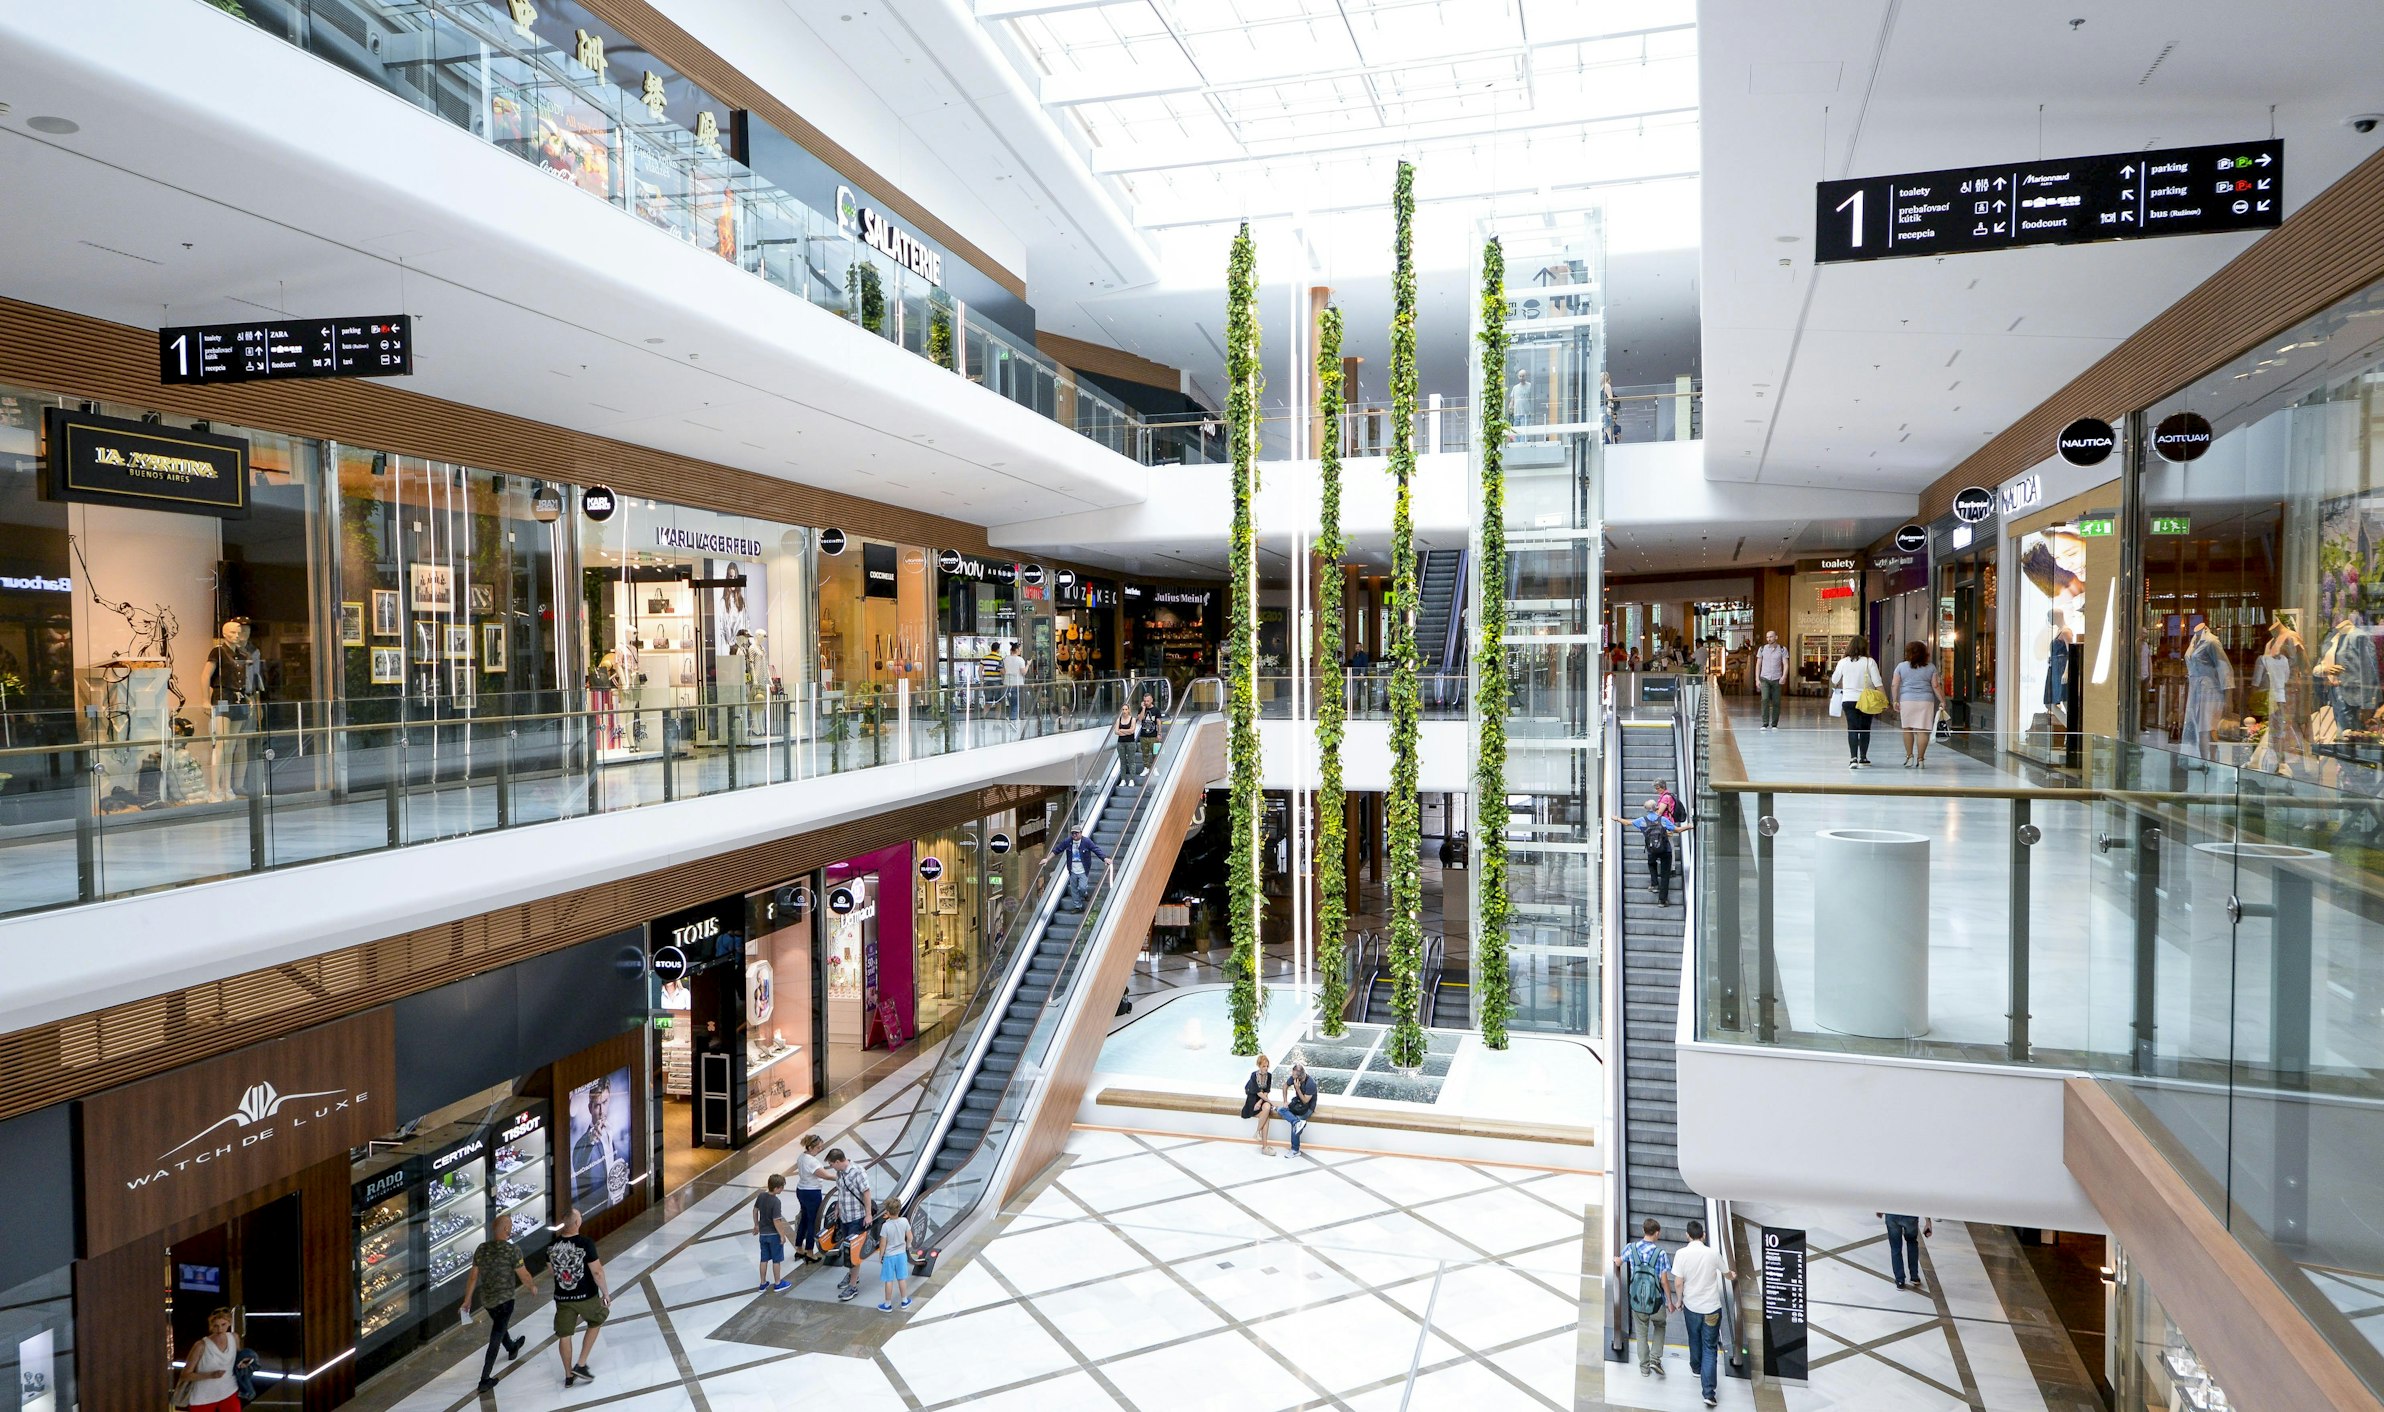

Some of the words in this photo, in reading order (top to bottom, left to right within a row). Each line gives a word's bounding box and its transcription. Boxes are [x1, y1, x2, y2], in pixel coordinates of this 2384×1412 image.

[2151, 162, 2188, 175] parking
[2022, 172, 2070, 186] Marionnaud
[1899, 186, 1931, 197] toalety
[2150, 186, 2188, 198] parking
[1899, 202, 1950, 215] prebaľovací
[2150, 209, 2168, 218] bus
[1836, 190, 1864, 247] 1
[1899, 213, 1922, 223] kútik
[2022, 218, 2067, 229] foodcourt
[1898, 229, 1936, 240] recepcia
[863, 207, 941, 287] SALATERIE
[341, 327, 361, 336] parking
[170, 335, 187, 375] 1
[271, 361, 297, 369] foodcourt
[2062, 438, 2113, 448] NAUTICA
[129, 469, 163, 480] BUENOS
[167, 474, 190, 483] AIRES
[1958, 500, 1988, 508] Barbour
[656, 527, 694, 549] KARL
[694, 532, 761, 556] LAGERFELD
[1821, 559, 1855, 569] toalety
[870, 571, 895, 581] COCCINELLE
[1155, 593, 1180, 602] Julius
[1181, 594, 1203, 603] Meinl
[841, 900, 875, 928] Dermacol
[672, 917, 719, 948] TOUS
[502, 1116, 541, 1143] TISSOT
[126, 1144, 232, 1190] WATCH
[242, 1127, 274, 1147] DE
[294, 1091, 369, 1127] LUXE
[433, 1140, 483, 1170] CERTINA
[366, 1170, 404, 1196] RADO
[1765, 1233, 1779, 1248] 10
